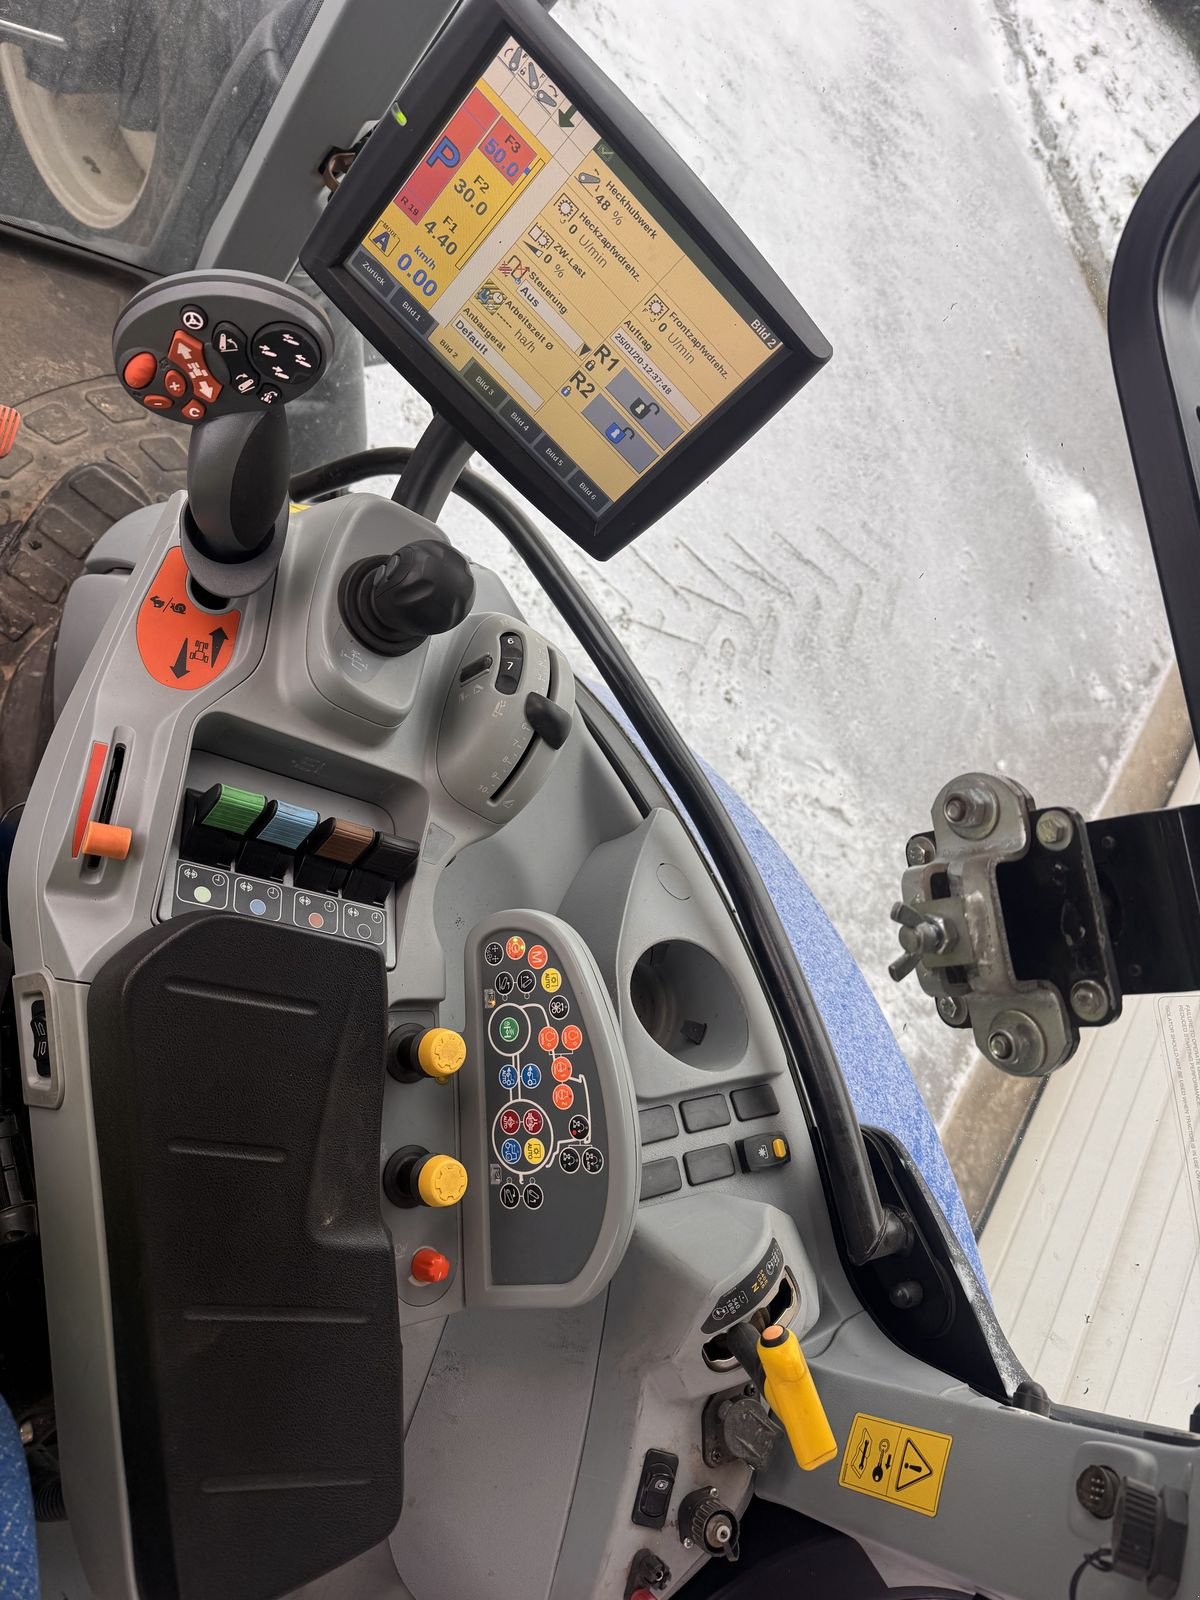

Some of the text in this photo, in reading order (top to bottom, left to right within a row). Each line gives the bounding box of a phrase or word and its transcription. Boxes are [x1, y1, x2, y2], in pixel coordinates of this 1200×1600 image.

[426, 136, 461, 168] P
[504, 134, 521, 153] F3
[484, 137, 519, 178] 50.0
[453, 178, 488, 216] 30.0
[473, 175, 490, 194] F2
[400, 196, 419, 216] R 19
[595, 194, 623, 226] 48 %
[605, 180, 658, 240] Heckhubwerk
[382, 222, 398, 239] MODE
[424, 220, 458, 256] 4.40
[442, 216, 458, 234] F1
[372, 231, 391, 253] A
[568, 224, 608, 269] 0 U/min
[578, 211, 641, 283] Heckzapfwdrehz.
[414, 245, 436, 271] km/h
[543, 254, 565, 279] 0 %
[553, 243, 587, 279] ZW-Last
[362, 260, 386, 286] Zurück
[397, 253, 438, 296] 0.00
[520, 286, 540, 308] Aus
[528, 271, 568, 315] Steuerung
[402, 301, 417, 318] Bild
[505, 300, 547, 344] Arbeitszeit
[439, 339, 453, 355] Bild
[455, 319, 489, 356] Default
[514, 328, 536, 353] ha/h
[623, 319, 653, 352] Auftrag
[658, 322, 696, 365] 0 U/min
[668, 311, 729, 380] Frontzapfwdrehz.
[750, 319, 777, 350] Bild 2
[594, 344, 620, 372] R1
[614, 333, 672, 395] 25/01/20-12:37:48
[475, 375, 489, 391] Bild
[569, 370, 596, 399] R2
[189, 407, 200, 417] C
[510, 411, 524, 427] Bild
[545, 447, 559, 463] Bild
[579, 482, 593, 497] Bild
[507, 637, 515, 645] 6
[506, 662, 514, 671] 7
[532, 951, 542, 963] M
[1171, 1033, 1179, 1057] SHOULD
[1185, 1115, 1195, 1142] TRACTOR
[752, 1282, 760, 1293] N
